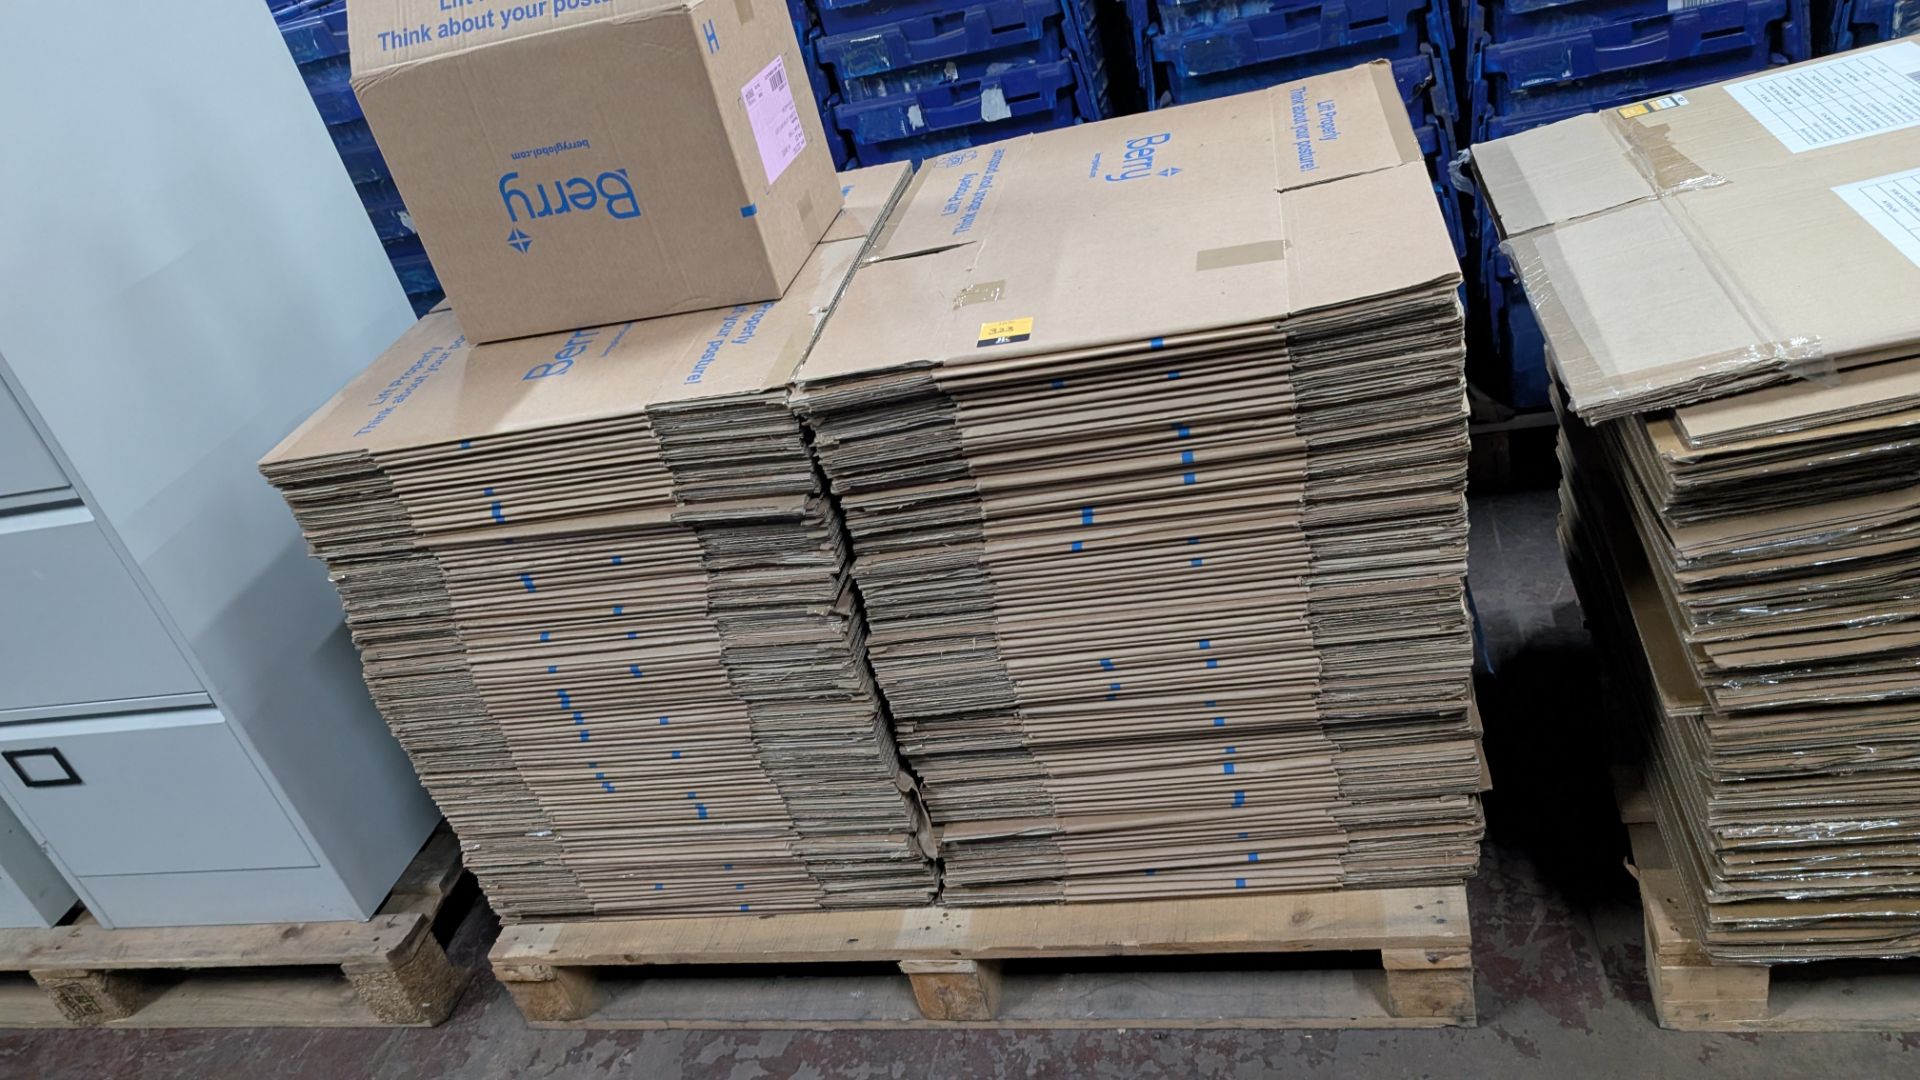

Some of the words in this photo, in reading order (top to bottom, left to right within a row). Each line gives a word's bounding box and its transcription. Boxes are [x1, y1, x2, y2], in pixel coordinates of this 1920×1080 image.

[378, 25, 432, 51] Think
[438, 12, 494, 38] about
[500, 1, 546, 30] your
[1290, 86, 1308, 106] Think
[1292, 104, 1310, 125] about
[1317, 111, 1342, 141] Properly
[1290, 123, 1310, 140] your
[511, 139, 591, 160] berryglobal.com
[1105, 133, 1170, 182] Berry
[499, 168, 641, 222] Berry
[948, 172, 979, 201] Properly
[952, 211, 977, 236] Think
[716, 314, 740, 337] your
[389, 346, 443, 387] Properly
[684, 339, 725, 385] posture!
[353, 405, 397, 437] Think
[392, 374, 429, 404] about
[424, 352, 450, 373] your
